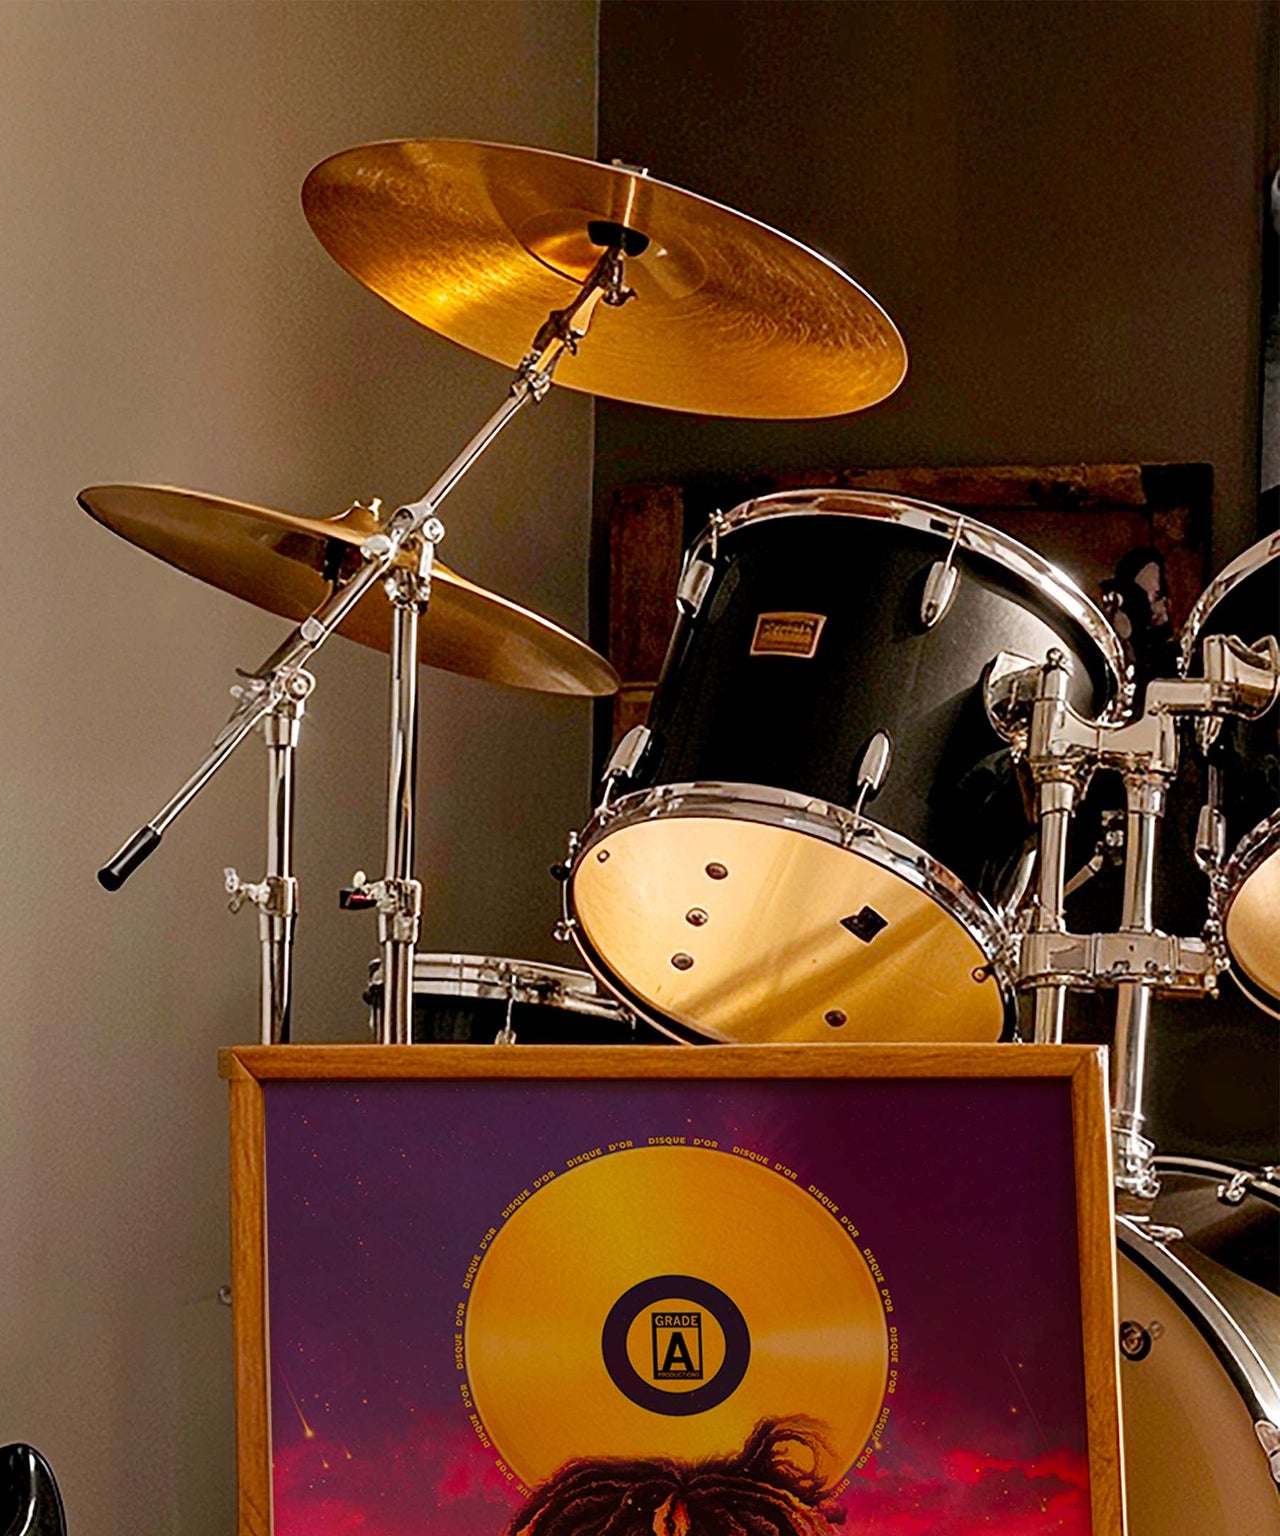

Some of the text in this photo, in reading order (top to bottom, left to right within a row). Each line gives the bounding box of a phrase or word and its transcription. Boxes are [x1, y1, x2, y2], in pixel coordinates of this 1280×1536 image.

[566, 1139, 634, 1168] DISQUE D'OR
[647, 1136, 718, 1149] DISQUE D'OR
[732, 1145, 798, 1180] DISQUE D'OR
[501, 1170, 556, 1219] DISQUE D'OR
[808, 1184, 860, 1238] DISQUE D'OR
[463, 1227, 497, 1290] DISQUE D'OR
[863, 1248, 894, 1313] DISQUE D'OR
[454, 1302, 466, 1370] DISQUE D'OR
[655, 1315, 698, 1326] GRADE
[662, 1332, 695, 1372] A
[887, 1326, 899, 1394] DISQUE D'OR
[460, 1383, 491, 1448] DISQUE D'OR
[856, 1407, 890, 1470] DISQUE D'OR
[495, 1458, 514, 1481] D'OR
